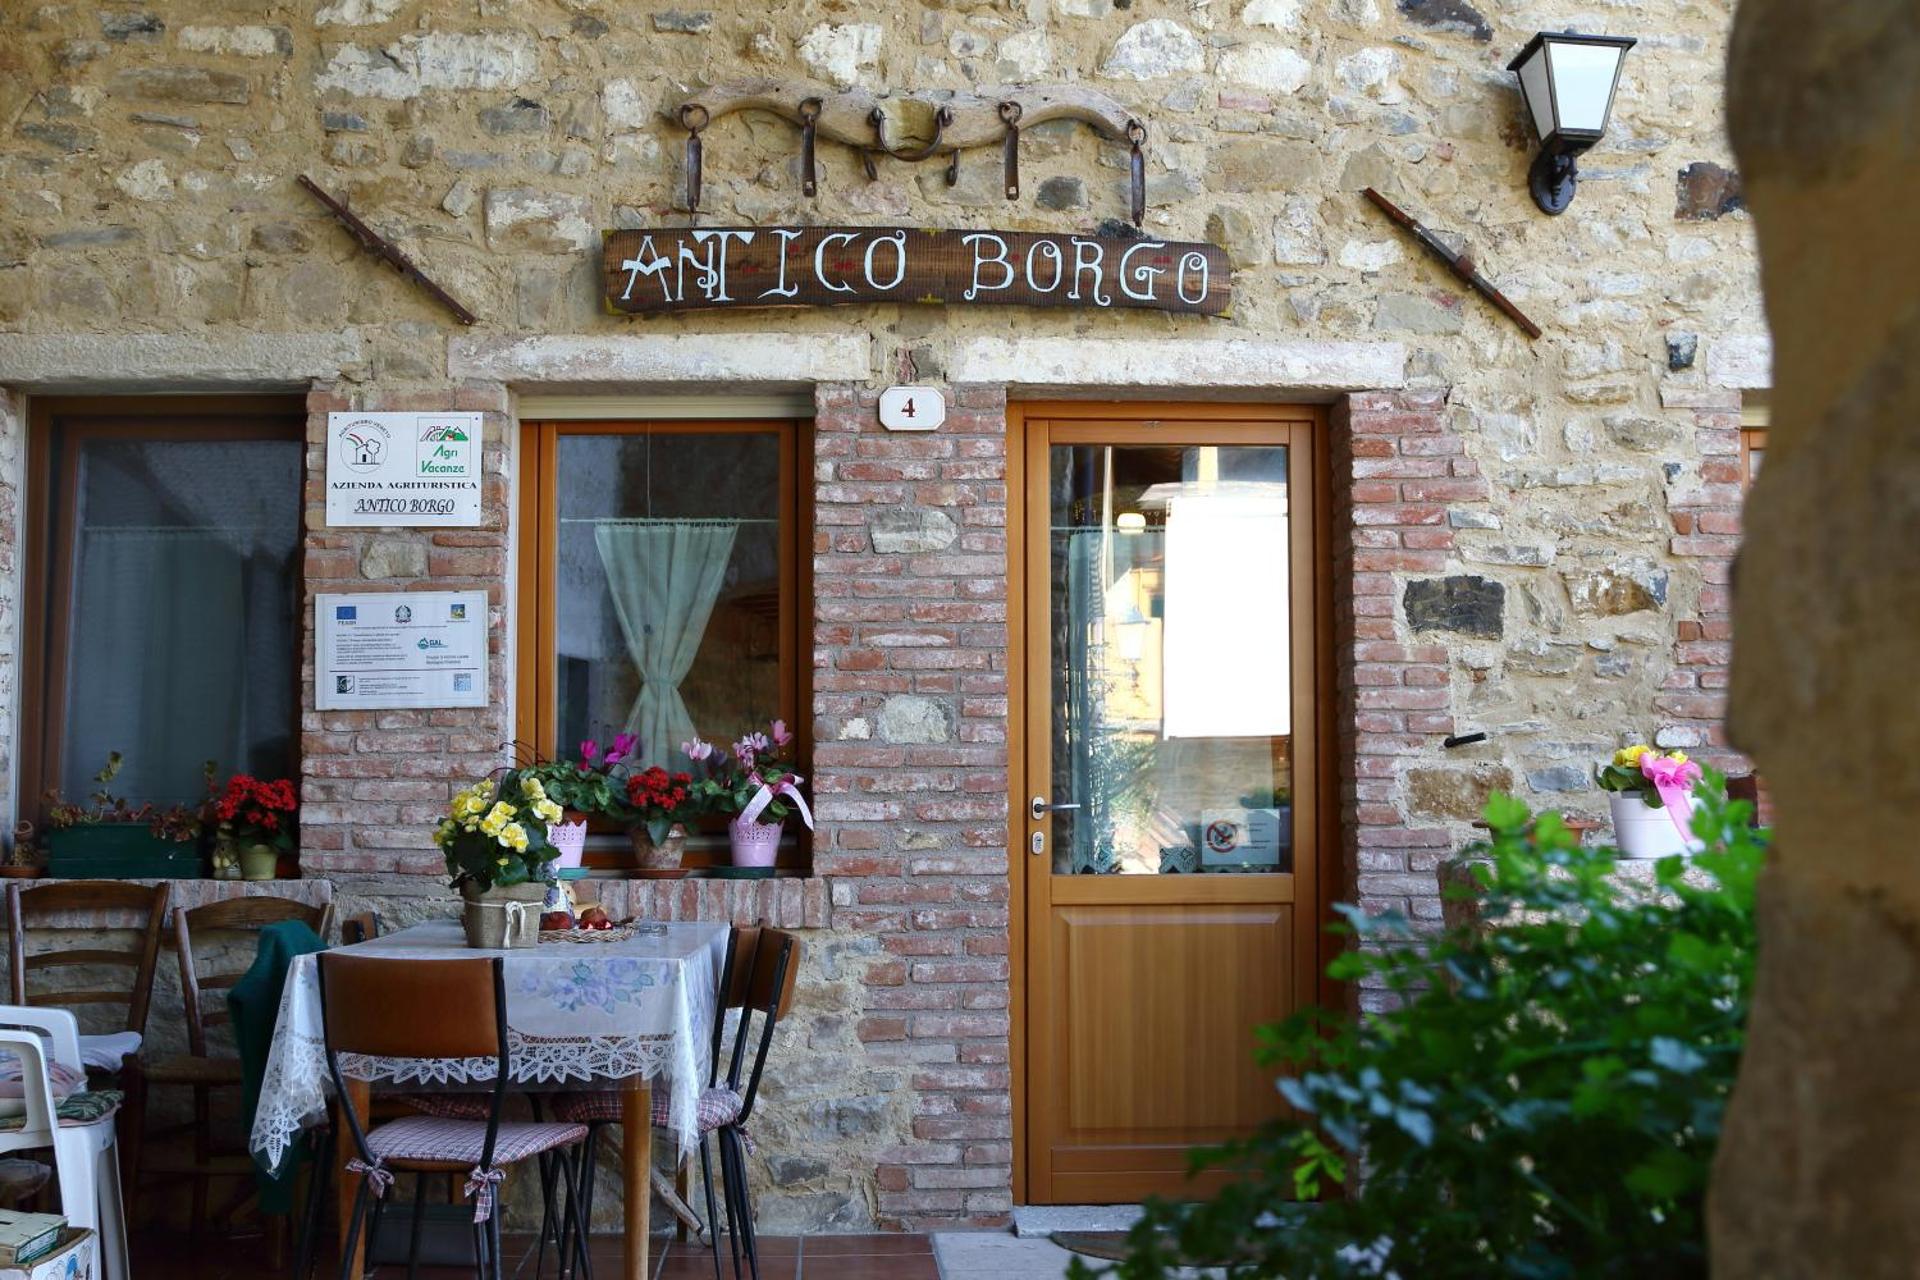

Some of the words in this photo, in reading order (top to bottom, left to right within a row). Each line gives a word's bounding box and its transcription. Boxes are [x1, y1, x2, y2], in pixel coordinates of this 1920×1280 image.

[621, 229, 906, 303] ANTICO
[962, 232, 1209, 307] BORGO
[901, 397, 915, 418] 4
[433, 445, 458, 459] Agri
[421, 460, 465, 473] Vacanze
[354, 498, 407, 513] ANTICO
[410, 499, 455, 515] BORGO
